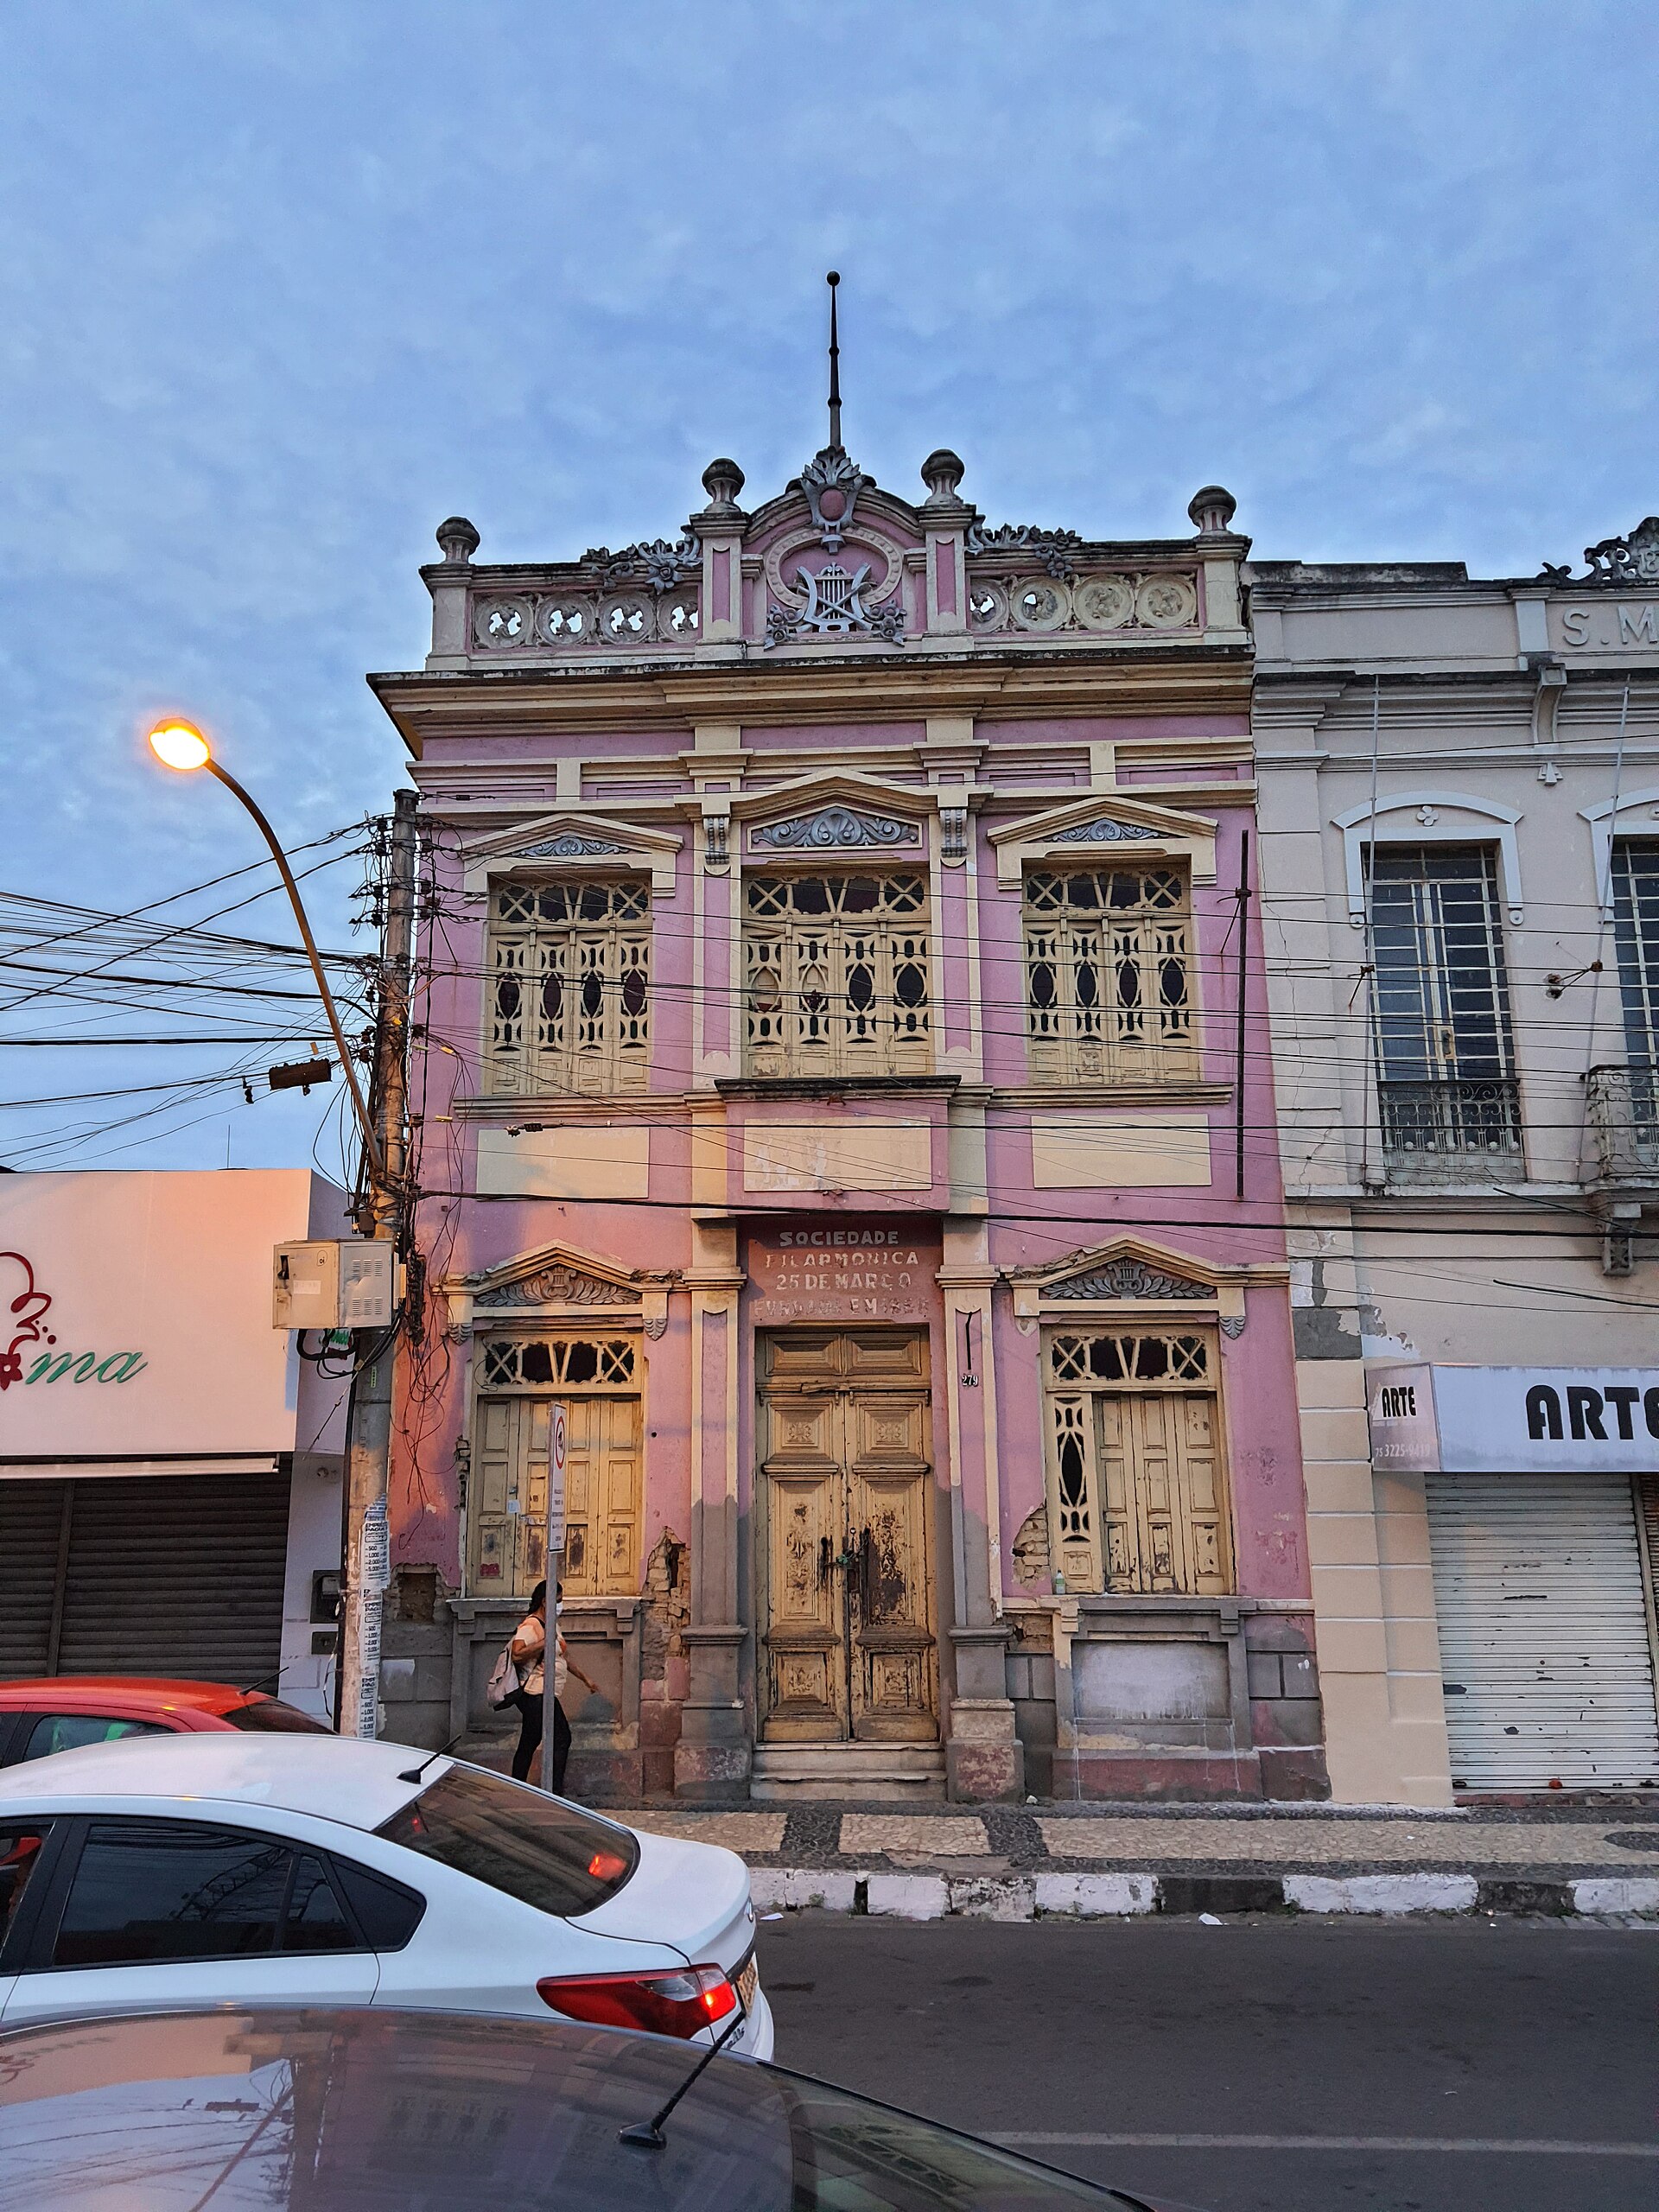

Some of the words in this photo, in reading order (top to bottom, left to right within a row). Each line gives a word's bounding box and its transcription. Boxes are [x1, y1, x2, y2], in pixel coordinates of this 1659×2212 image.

[779, 1230, 899, 1247] SOCIEDADE
[766, 1251, 919, 1268] FILARMONICA
[776, 1274, 799, 1291] 25
[804, 1273, 831, 1290] DE
[835, 1271, 912, 1291] MARÇO
[850, 1297, 877, 1314] EM
[962, 1374, 978, 1387] 279
[1382, 1386, 1417, 1418] ARTE
